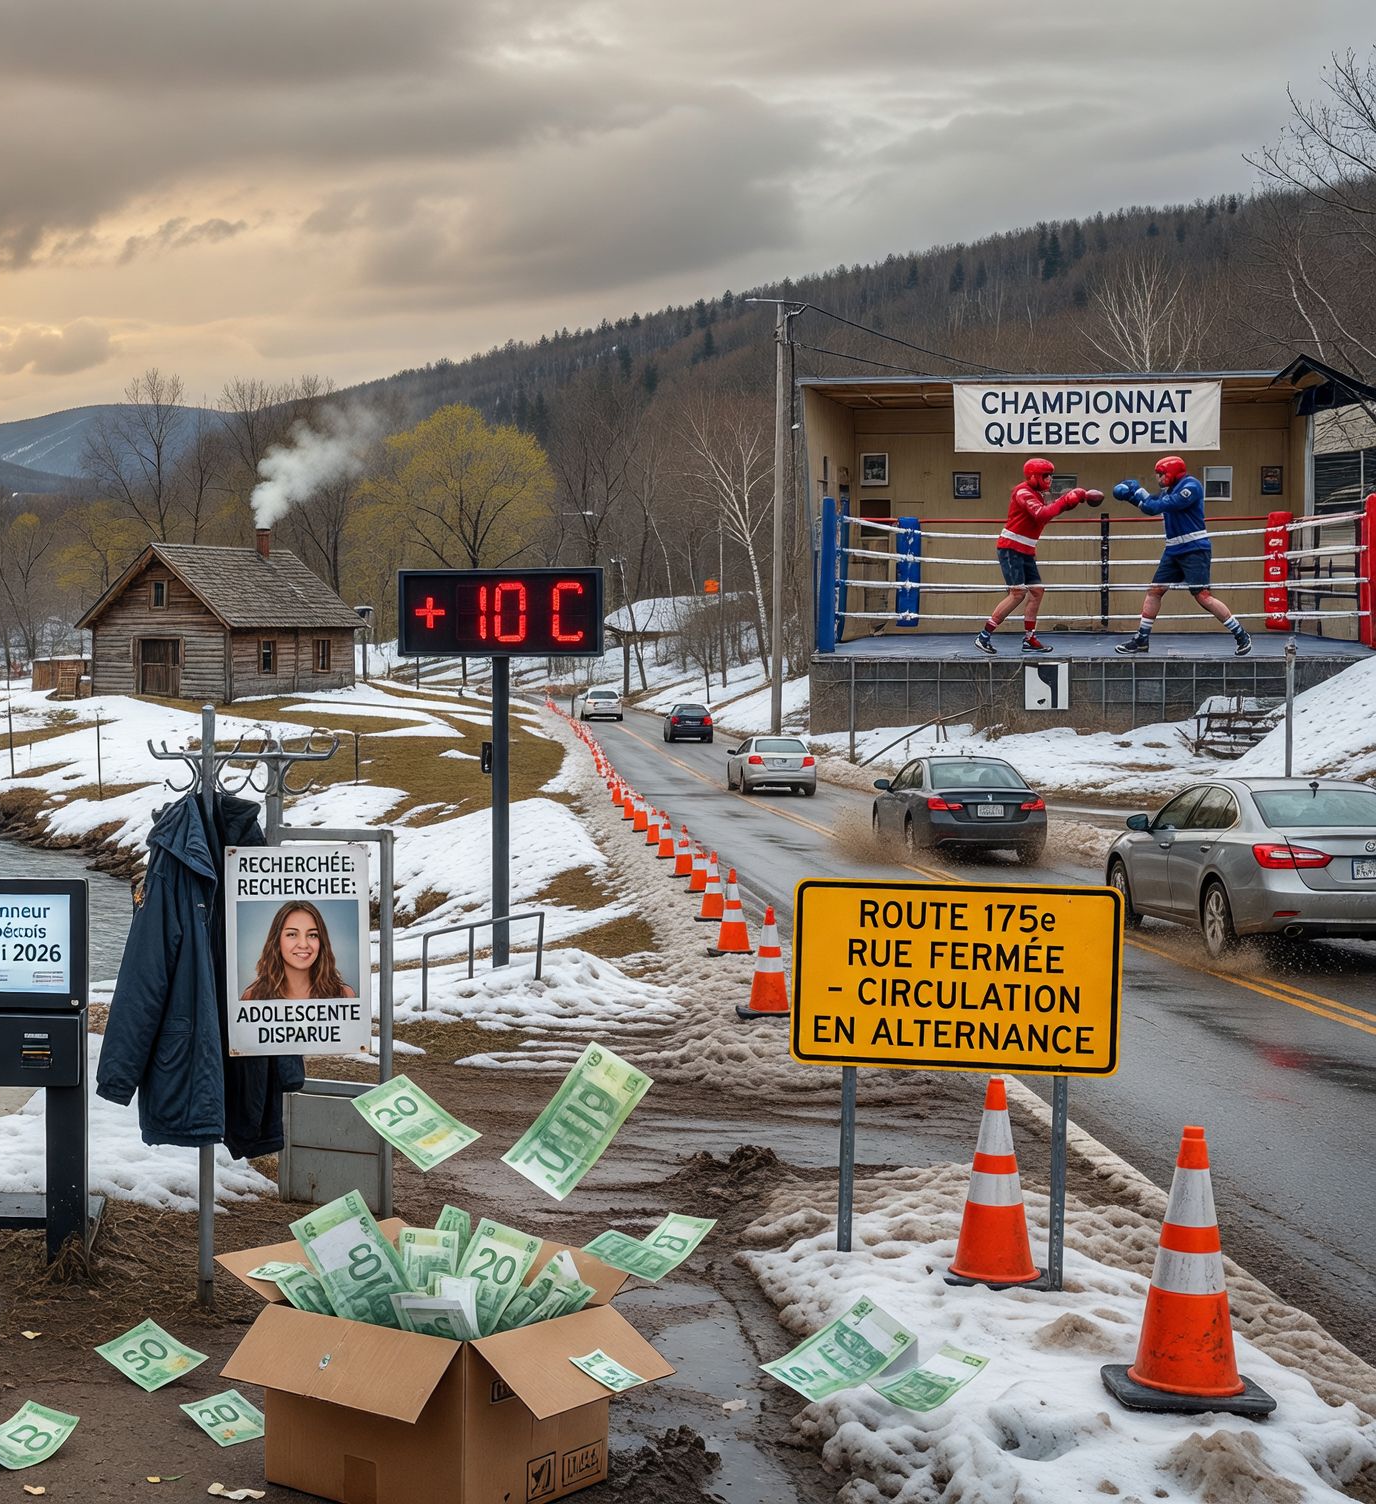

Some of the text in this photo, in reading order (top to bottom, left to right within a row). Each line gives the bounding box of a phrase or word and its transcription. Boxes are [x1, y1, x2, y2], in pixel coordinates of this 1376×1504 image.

[980, 389, 1193, 414] CHAMPIONNAT
[984, 416, 1188, 447] QUÉBEC OPEN
[478, 581, 527, 643] 10
[551, 581, 584, 643] C
[238, 851, 355, 873] RECHERCHÉE:
[237, 877, 357, 896] RECHERCHEE:
[859, 899, 1056, 933] ROUTE 175e
[12, 943, 62, 963] 2026
[847, 936, 1065, 974] RUE FERMÉE
[857, 977, 1080, 1014] CIRCULATION
[236, 1003, 361, 1023] ADOLESCENTE
[258, 1026, 342, 1044] DISPARUE
[813, 1015, 1095, 1055] EN ALTERNANCE
[470, 1247, 517, 1286] 20
